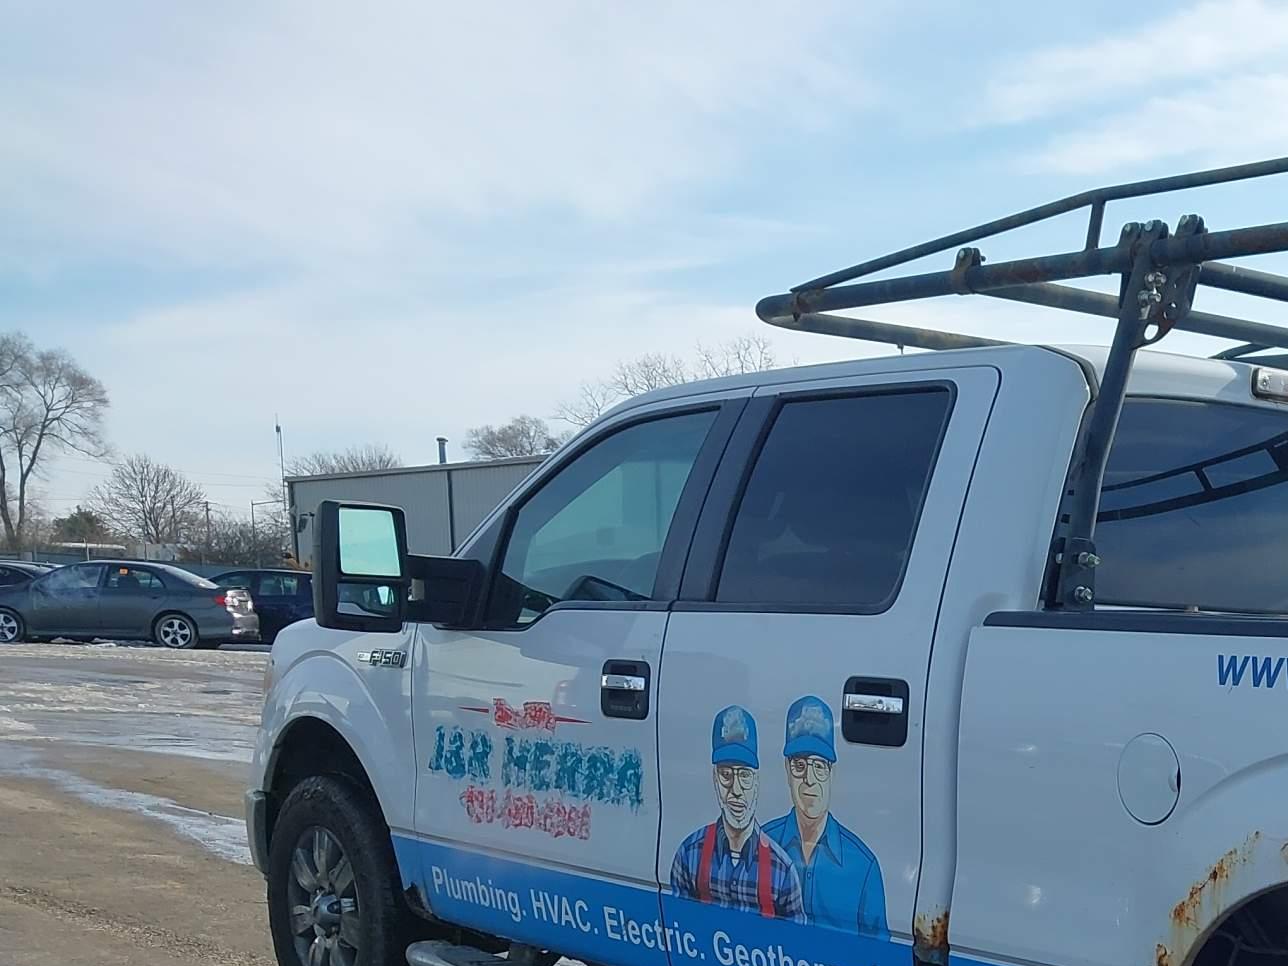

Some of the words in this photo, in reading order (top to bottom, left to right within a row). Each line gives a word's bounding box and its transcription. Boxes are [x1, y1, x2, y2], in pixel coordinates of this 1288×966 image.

[431, 866, 527, 923] Plumbing.
[530, 889, 599, 934] HVAC.
[602, 906, 706, 960] Electric.
